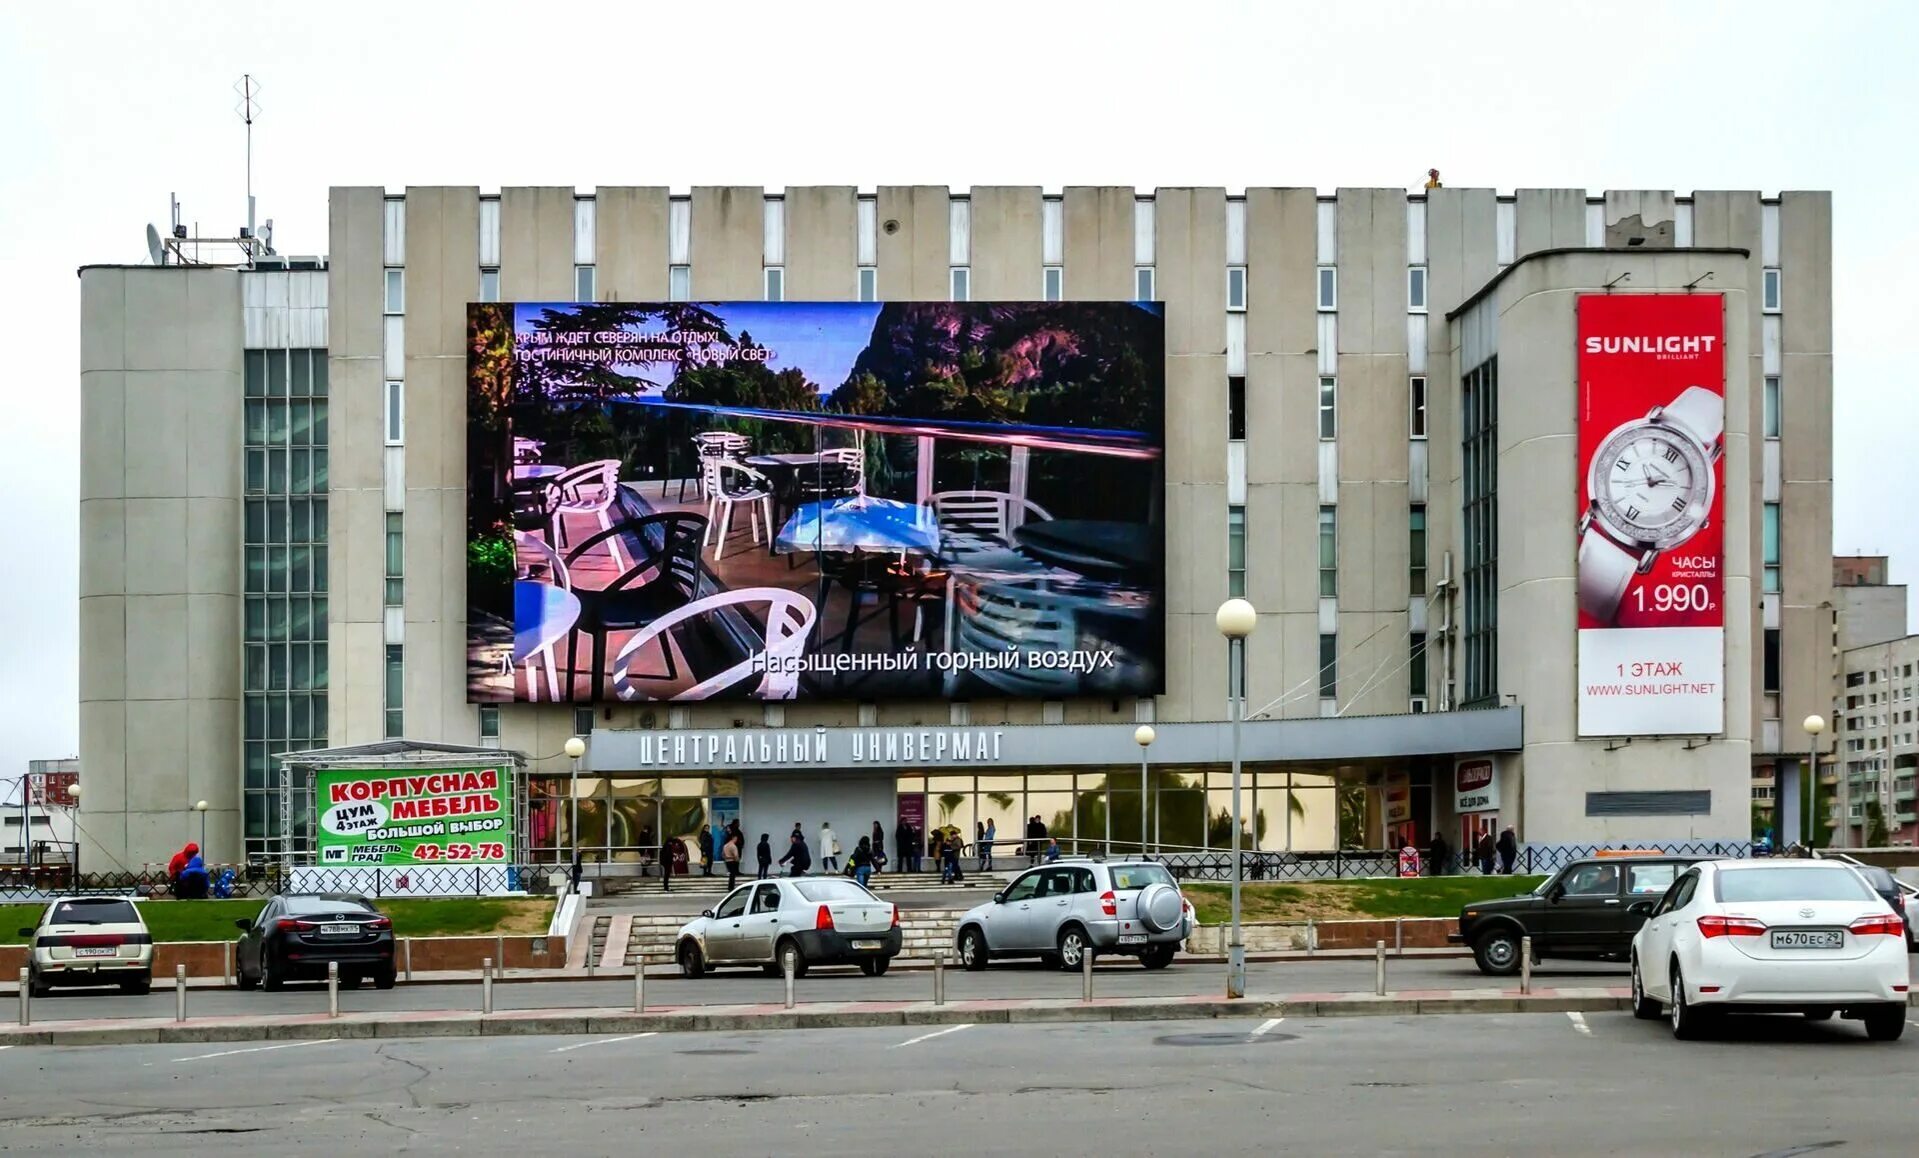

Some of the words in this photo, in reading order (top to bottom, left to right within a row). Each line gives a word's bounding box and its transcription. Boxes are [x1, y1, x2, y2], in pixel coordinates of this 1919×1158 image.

[515, 331, 553, 344] КРЫМ
[555, 331, 591, 346] ЖДЕТ
[593, 331, 648, 344] СЕВЕРЯН
[651, 331, 669, 343] НА
[671, 331, 719, 344] ОТДЫХ!
[1586, 336, 1716, 353] SUNLIGHT
[514, 346, 612, 361] ГОСТИНИЧНЫЙ
[615, 348, 684, 361] КОМПЛЕКС
[686, 346, 739, 361] «НОВЫЙ
[741, 348, 777, 360] СВЕТ»
[1672, 556, 1716, 569] ЧАСЫ
[1632, 584, 1709, 612] 1.990
[750, 646, 917, 676] Насыщенный
[926, 644, 1020, 676] горный
[1028, 649, 1114, 674] воздух
[1617, 664, 1624, 678] 1
[1631, 662, 1683, 677] ЭТАЖ
[1586, 683, 1716, 696] WWW.SUNLIGHT.NET
[641, 728, 827, 765] ЦЕНТРАЛЬНЫЙ
[852, 731, 1004, 762] УНИВЕРМАГ
[331, 770, 498, 803] КОРПУСНАЯ
[336, 804, 375, 822] ЦУМ
[391, 794, 501, 821] МЕБЕЛЬ
[366, 822, 446, 841] БОЛЬШОЙ
[450, 818, 504, 835] ВЫБОР
[352, 853, 383, 862] ГРАД
[353, 845, 402, 854] МЕБЕЛЬ
[413, 842, 506, 861] 42-52-78
